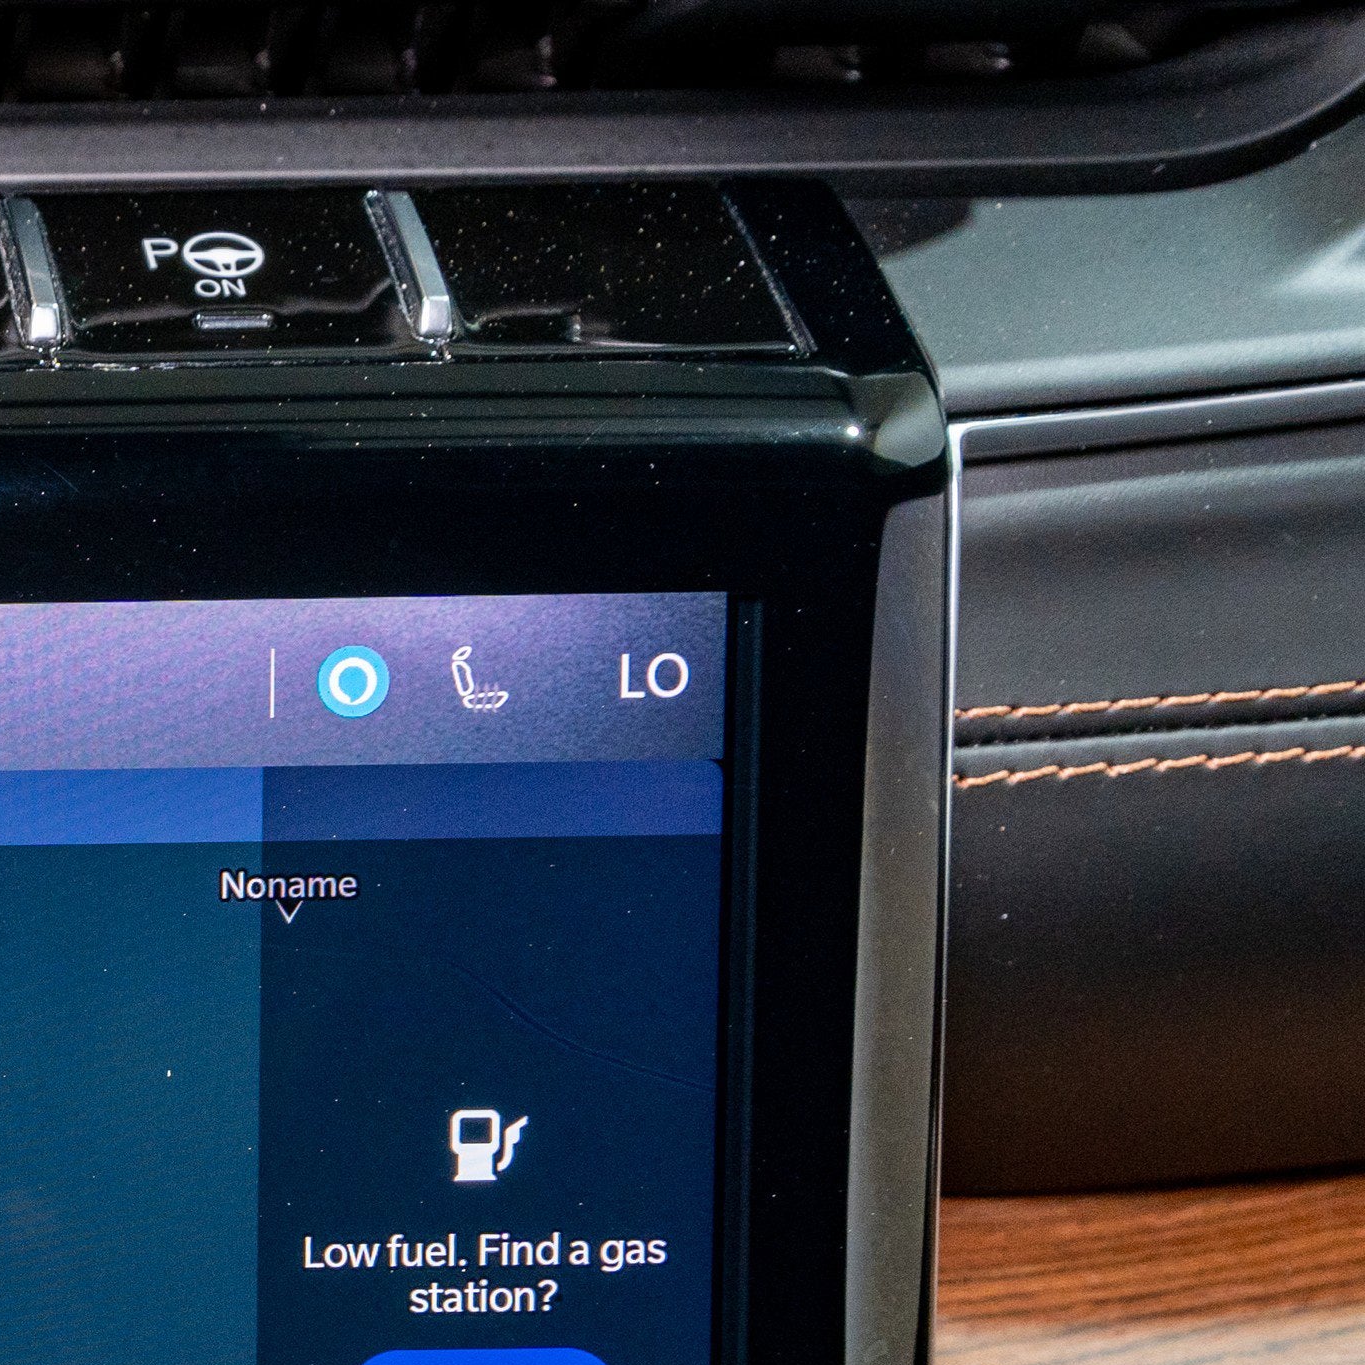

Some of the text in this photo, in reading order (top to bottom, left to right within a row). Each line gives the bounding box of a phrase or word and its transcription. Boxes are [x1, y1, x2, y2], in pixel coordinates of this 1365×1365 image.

[142, 238, 177, 269] P
[195, 278, 246, 297] ON
[621, 653, 688, 698] LO
[222, 871, 356, 899] Noname
[305, 1232, 666, 1272] Low fuel. Find a gas
[410, 1280, 557, 1312] station?
